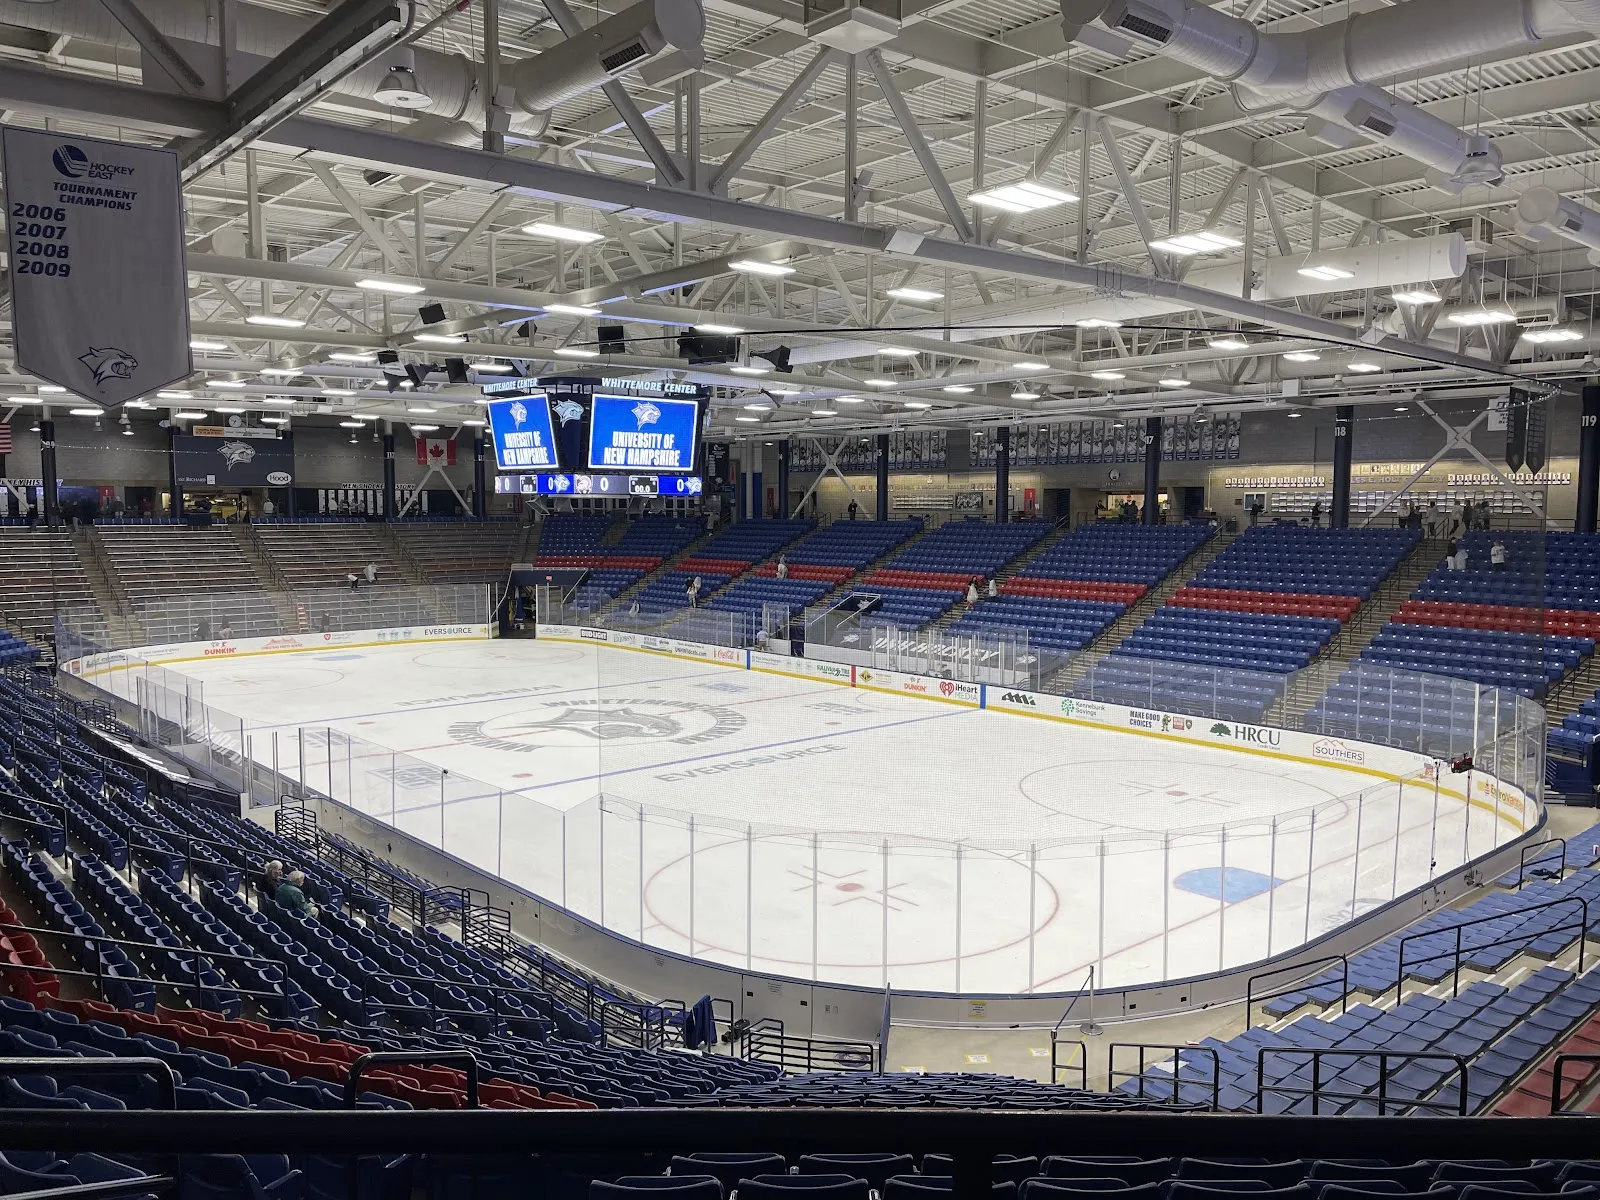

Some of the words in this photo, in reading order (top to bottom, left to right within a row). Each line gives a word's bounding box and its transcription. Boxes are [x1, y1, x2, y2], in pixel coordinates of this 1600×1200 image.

[88, 170, 114, 180] EAST
[90, 163, 135, 175] HOCKEY
[53, 182, 137, 200] TOURNAMENT
[59, 194, 132, 211] CHAMPIONS
[12, 202, 66, 222] 2006
[15, 221, 67, 240] 2007
[16, 241, 70, 259] 2008
[17, 260, 71, 277] 2009
[483, 381, 517, 393] WHITTEMORE
[517, 377, 538, 389] CENTER
[601, 377, 662, 391] WHITTEMORE
[664, 383, 697, 394] CENTER
[1582, 415, 1597, 427] 119
[504, 432, 533, 448] UNIVERSITY
[533, 431, 541, 447] OF
[612, 431, 662, 448] UNIVERSITY
[663, 434, 675, 449] OF
[503, 449, 516, 465] NEW
[516, 447, 549, 465] HAMPSHIRE
[603, 447, 626, 465] NEW
[627, 448, 680, 466] HAMPSHIRE
[505, 477, 510, 491] 0
[548, 477, 554, 491] 0
[600, 477, 608, 492] 0
[634, 485, 650, 493] 00.0
[676, 479, 684, 492] 0
[424, 628, 472, 636] EVERSOURCE
[204, 647, 237, 655] DUNKIN'
[955, 684, 978, 694] iHeart
[1076, 701, 1106, 711] Kennebunk
[1076, 708, 1097, 716] Savings
[1129, 718, 1152, 728] CHOICES
[1130, 711, 1145, 719] MAKE
[1145, 712, 1161, 722] GOOD
[1235, 725, 1281, 746] HRCU
[1315, 746, 1363, 761] SOUTHERS
[653, 743, 849, 782] EVERSOURCE
